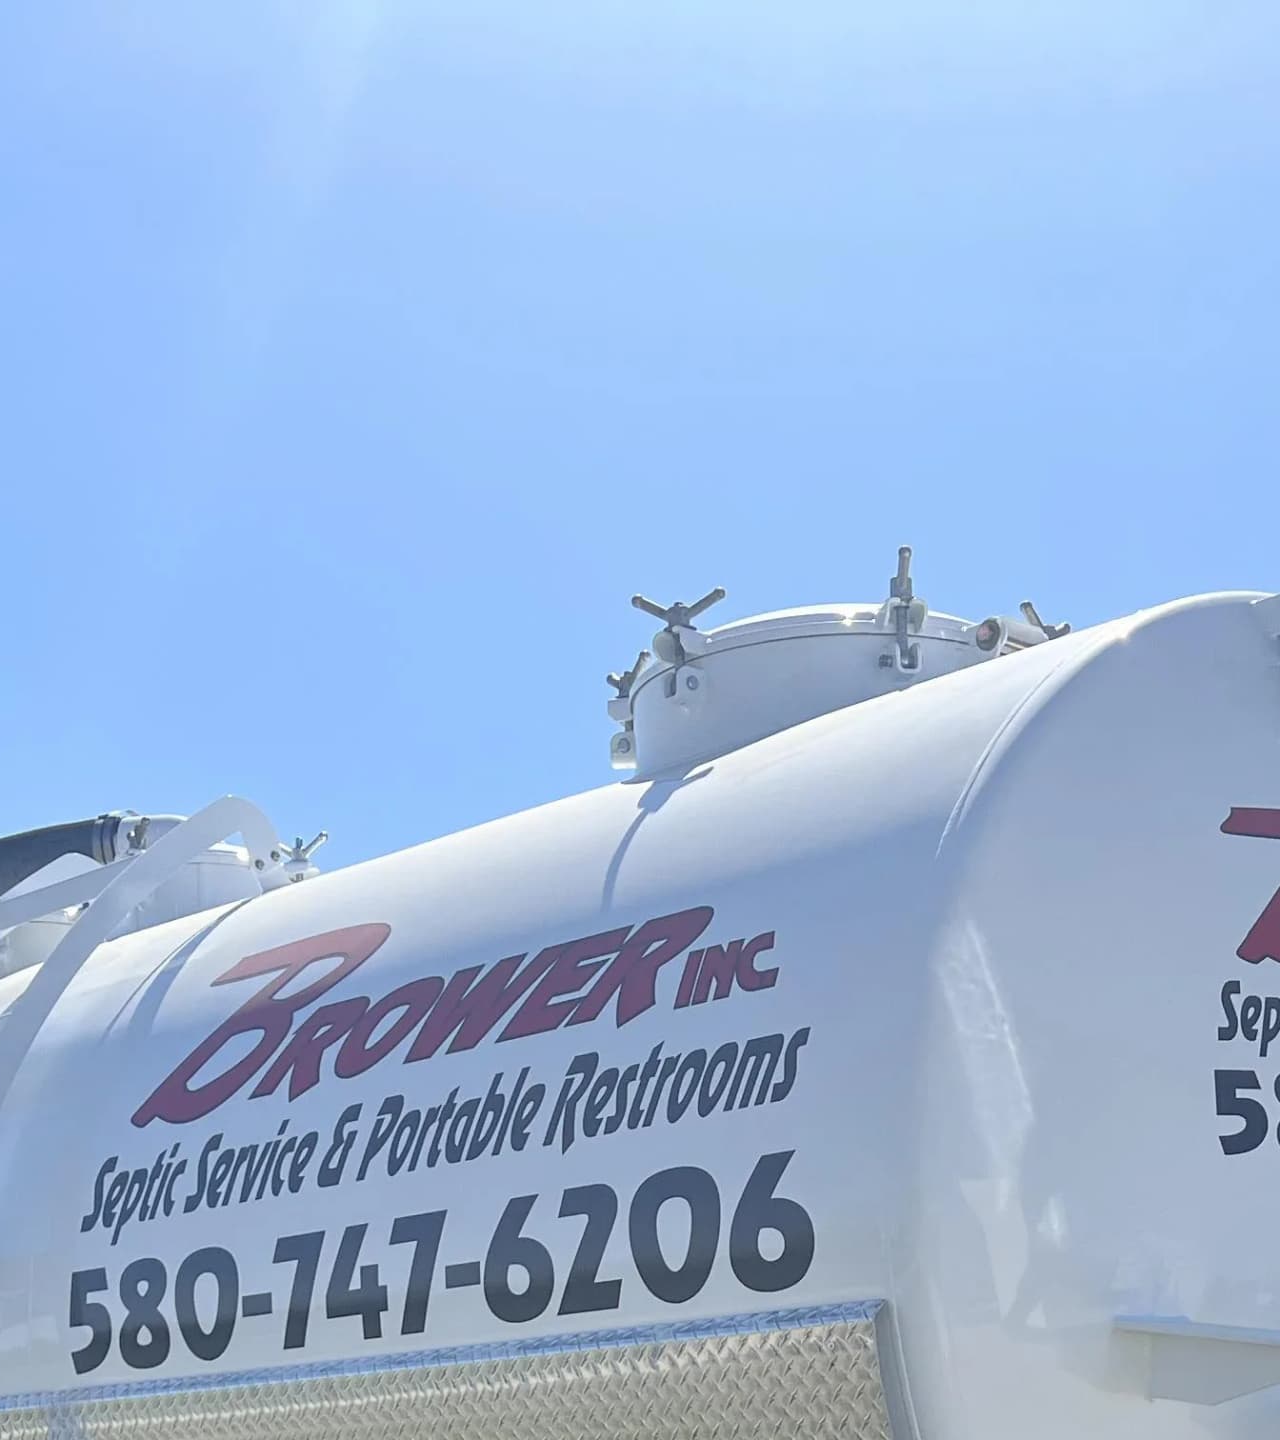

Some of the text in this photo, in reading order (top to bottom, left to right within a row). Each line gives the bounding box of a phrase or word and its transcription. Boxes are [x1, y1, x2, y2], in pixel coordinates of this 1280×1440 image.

[131, 906, 780, 1128] BROWER INC
[81, 1027, 811, 1245] Septic Service & Portable Restrooms
[69, 1150, 816, 1375] 580-747-6206
